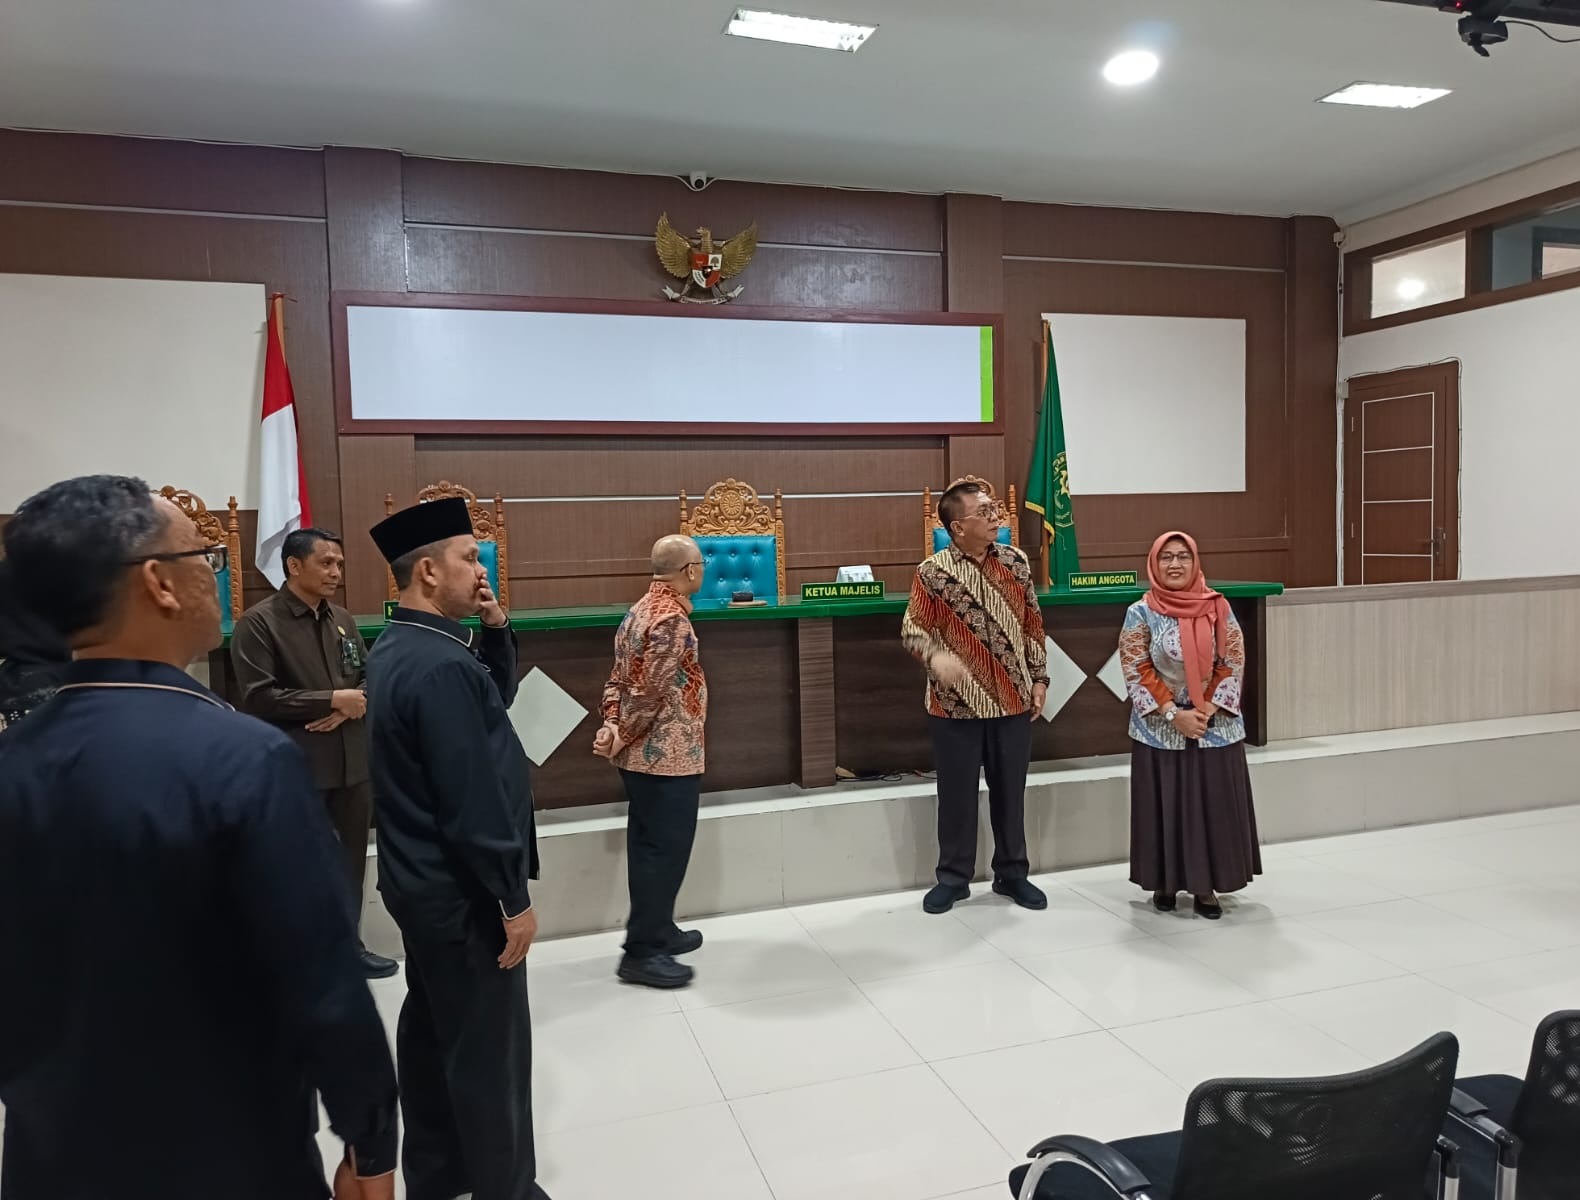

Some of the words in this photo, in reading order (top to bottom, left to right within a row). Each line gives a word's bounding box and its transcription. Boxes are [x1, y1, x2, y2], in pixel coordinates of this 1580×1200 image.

[1071, 576, 1097, 586] HAKIM
[1098, 575, 1135, 585] ANGGOTA
[805, 586, 838, 597] KETUA
[840, 585, 881, 596] MAJELIS
